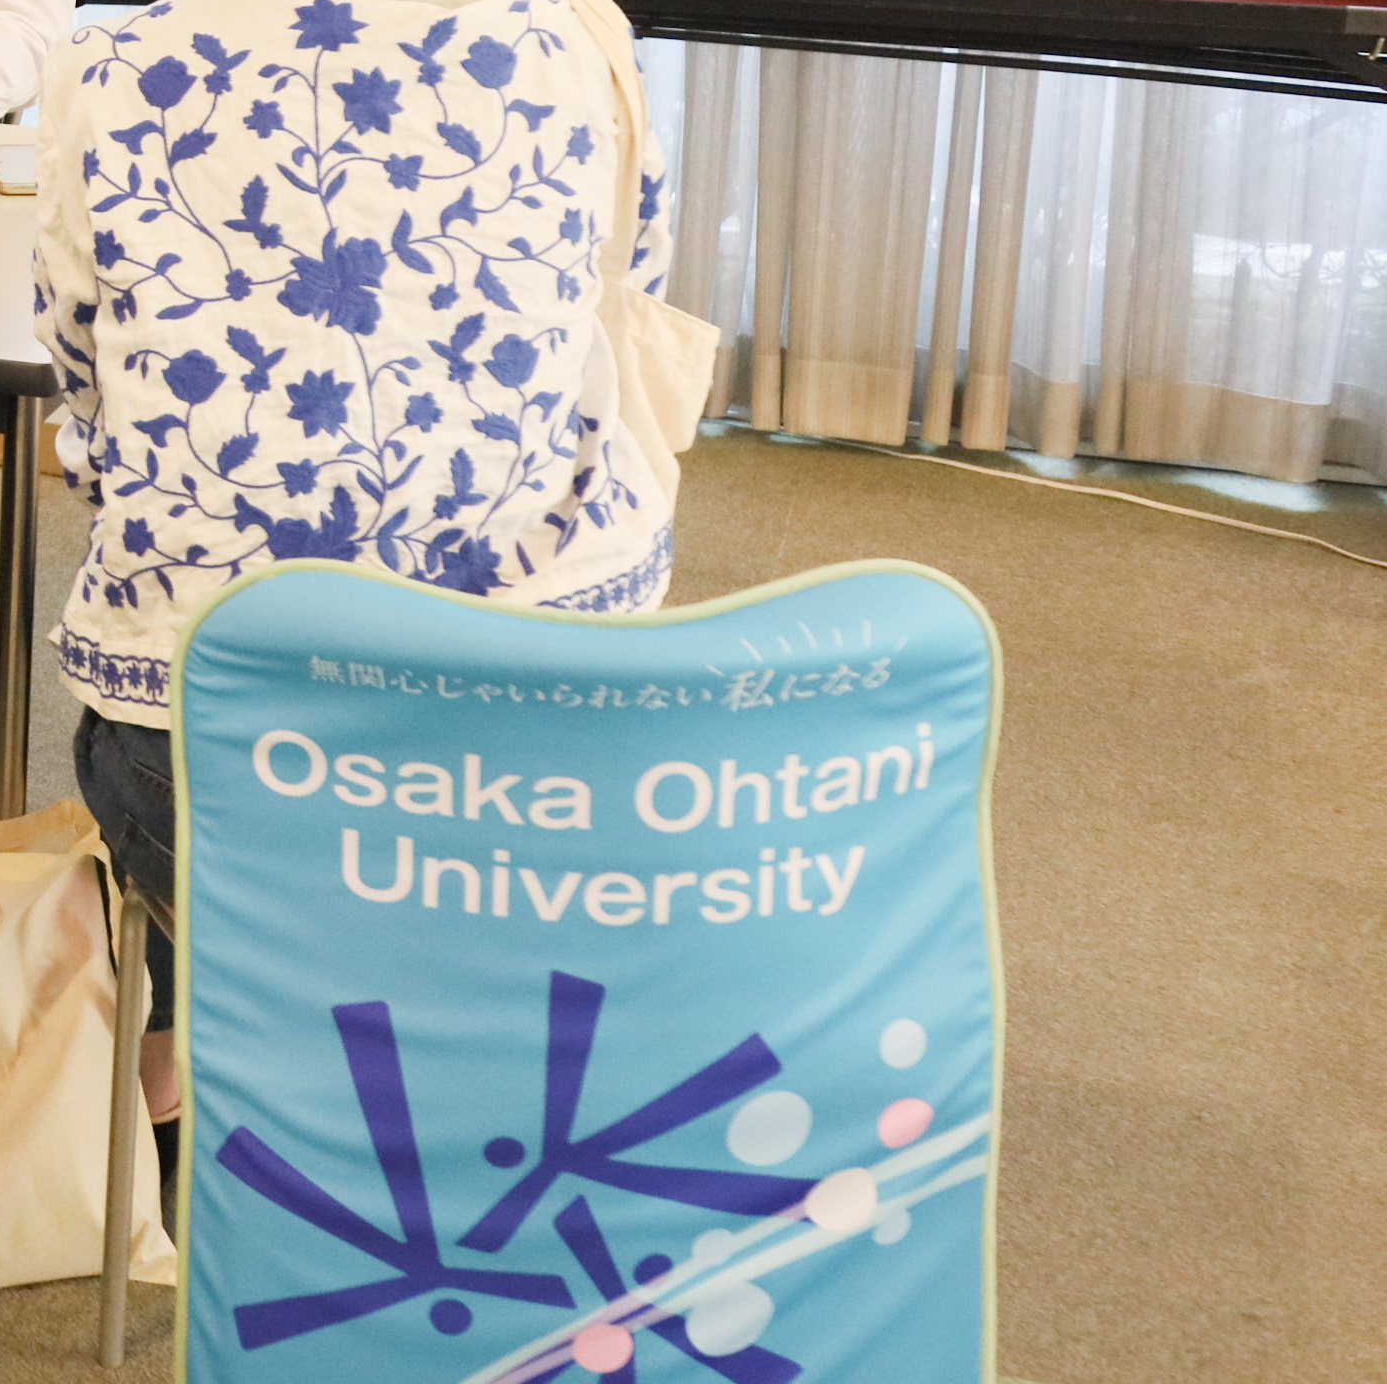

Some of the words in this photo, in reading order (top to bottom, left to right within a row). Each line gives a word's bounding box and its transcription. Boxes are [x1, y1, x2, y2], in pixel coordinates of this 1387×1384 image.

[251, 729, 593, 830] Osaka
[634, 722, 935, 833] Ohtani
[341, 827, 866, 927] University
